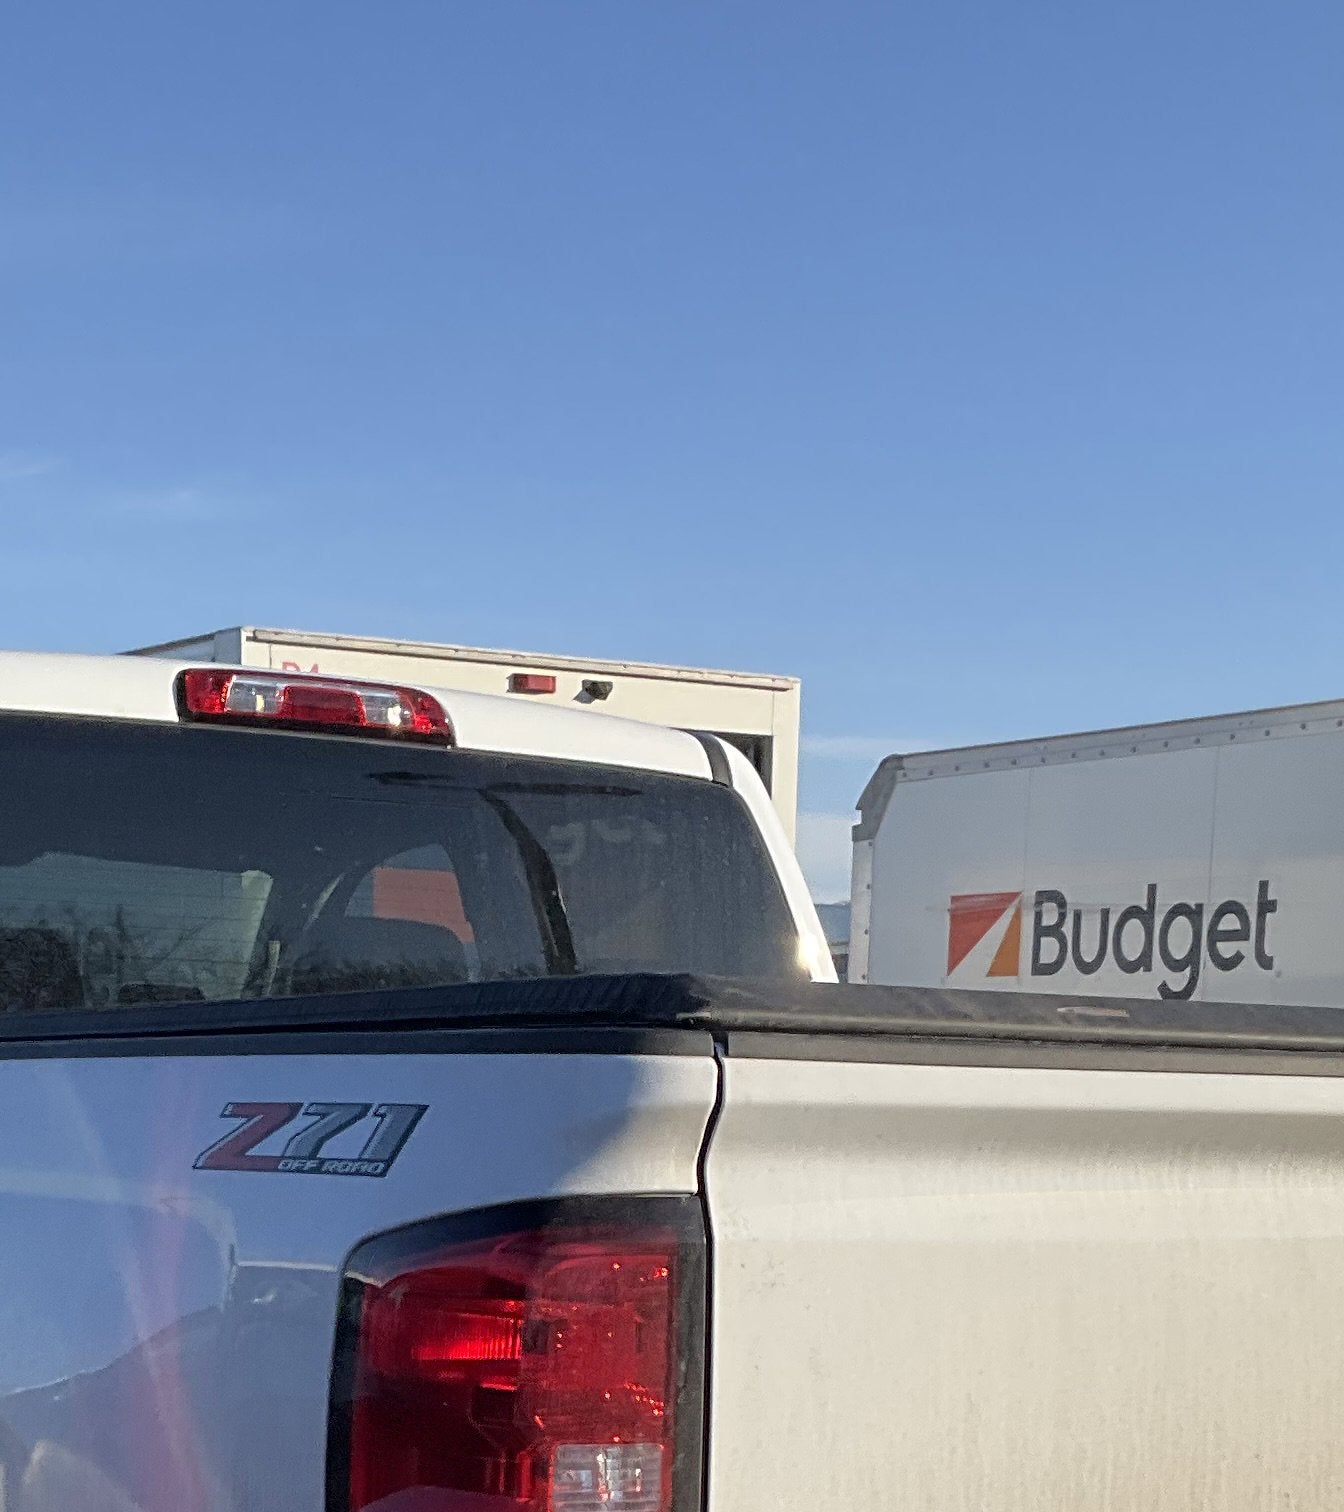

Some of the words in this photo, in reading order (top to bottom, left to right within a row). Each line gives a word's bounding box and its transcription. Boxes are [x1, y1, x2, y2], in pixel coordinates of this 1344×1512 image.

[1031, 879, 1278, 1001] Budget
[193, 1101, 430, 1174] Z71
[277, 1159, 320, 1171] OFF
[321, 1160, 386, 1174] ROAD
